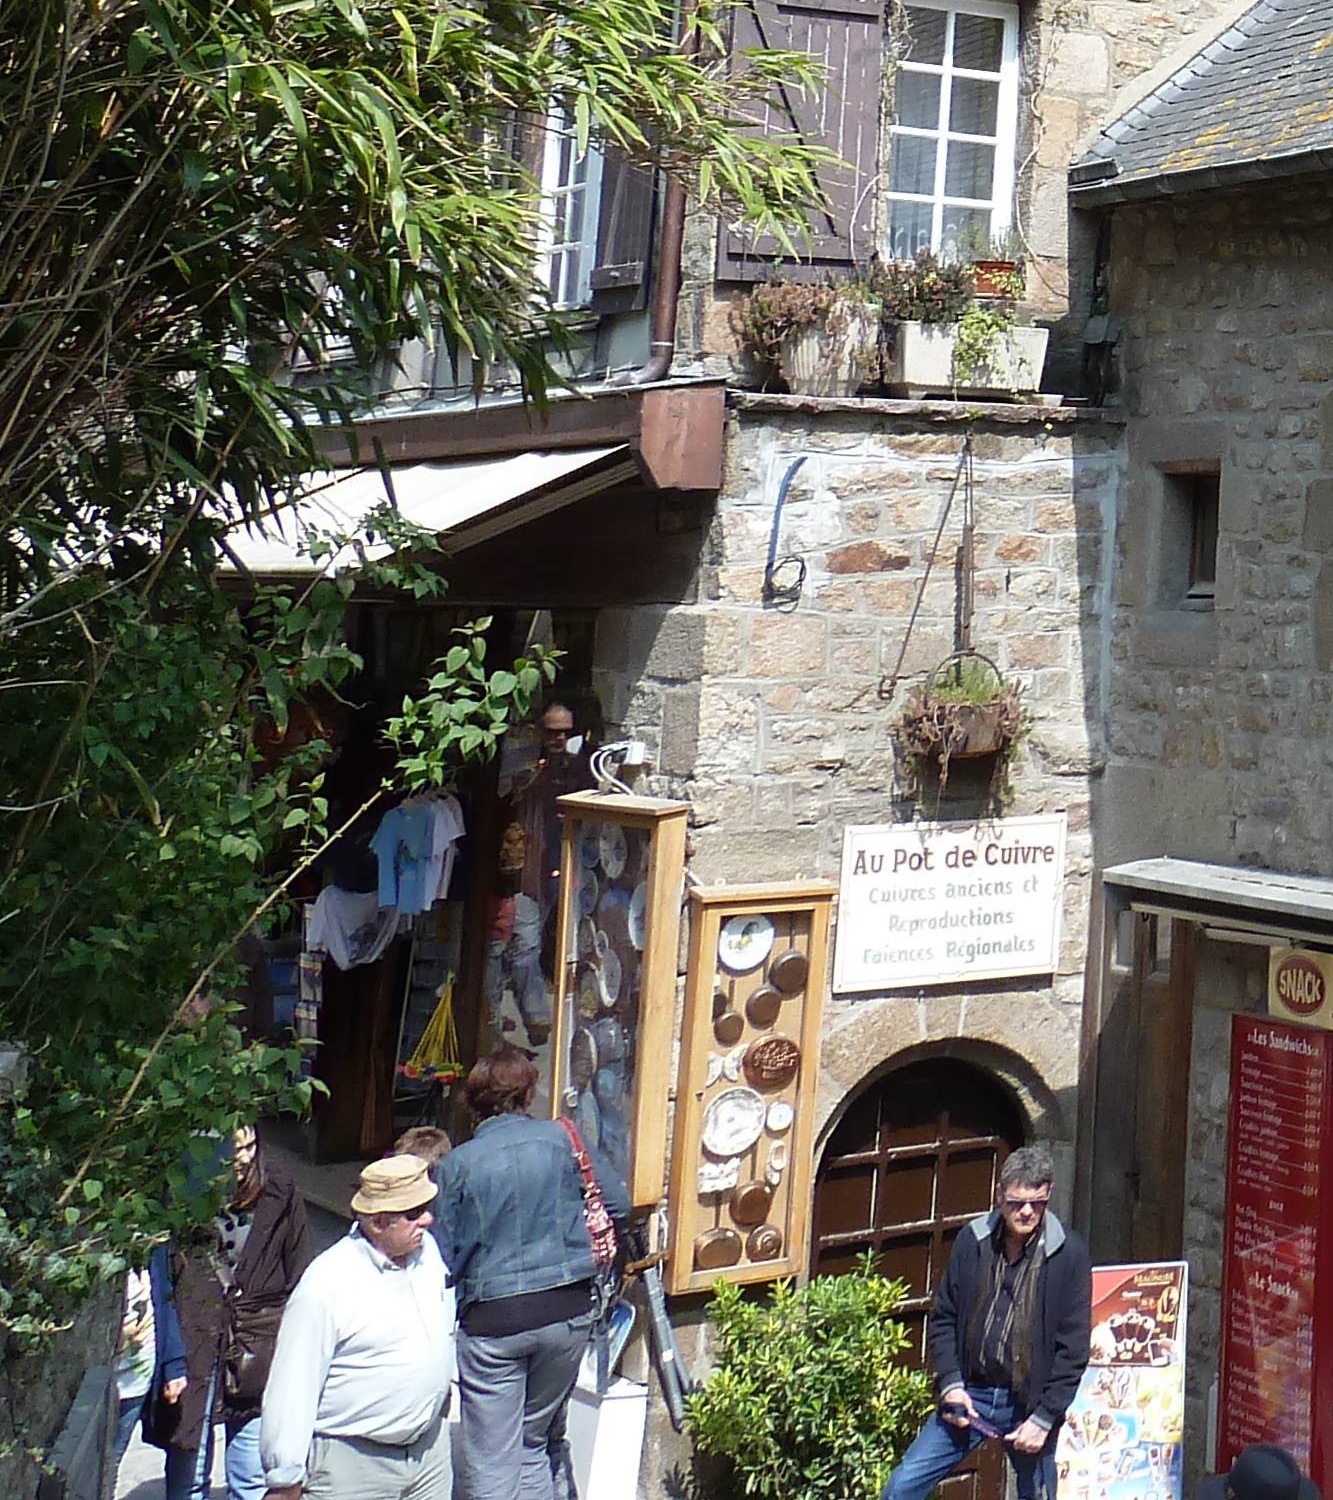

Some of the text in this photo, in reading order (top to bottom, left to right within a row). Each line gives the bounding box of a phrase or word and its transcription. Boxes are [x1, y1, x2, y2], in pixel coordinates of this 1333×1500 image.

[852, 839, 1055, 875] Au Pot de Cuivre
[869, 874, 1040, 904] Cuivres anciens et
[888, 907, 1015, 936] Reproductions
[1279, 968, 1321, 1004] SNACK
